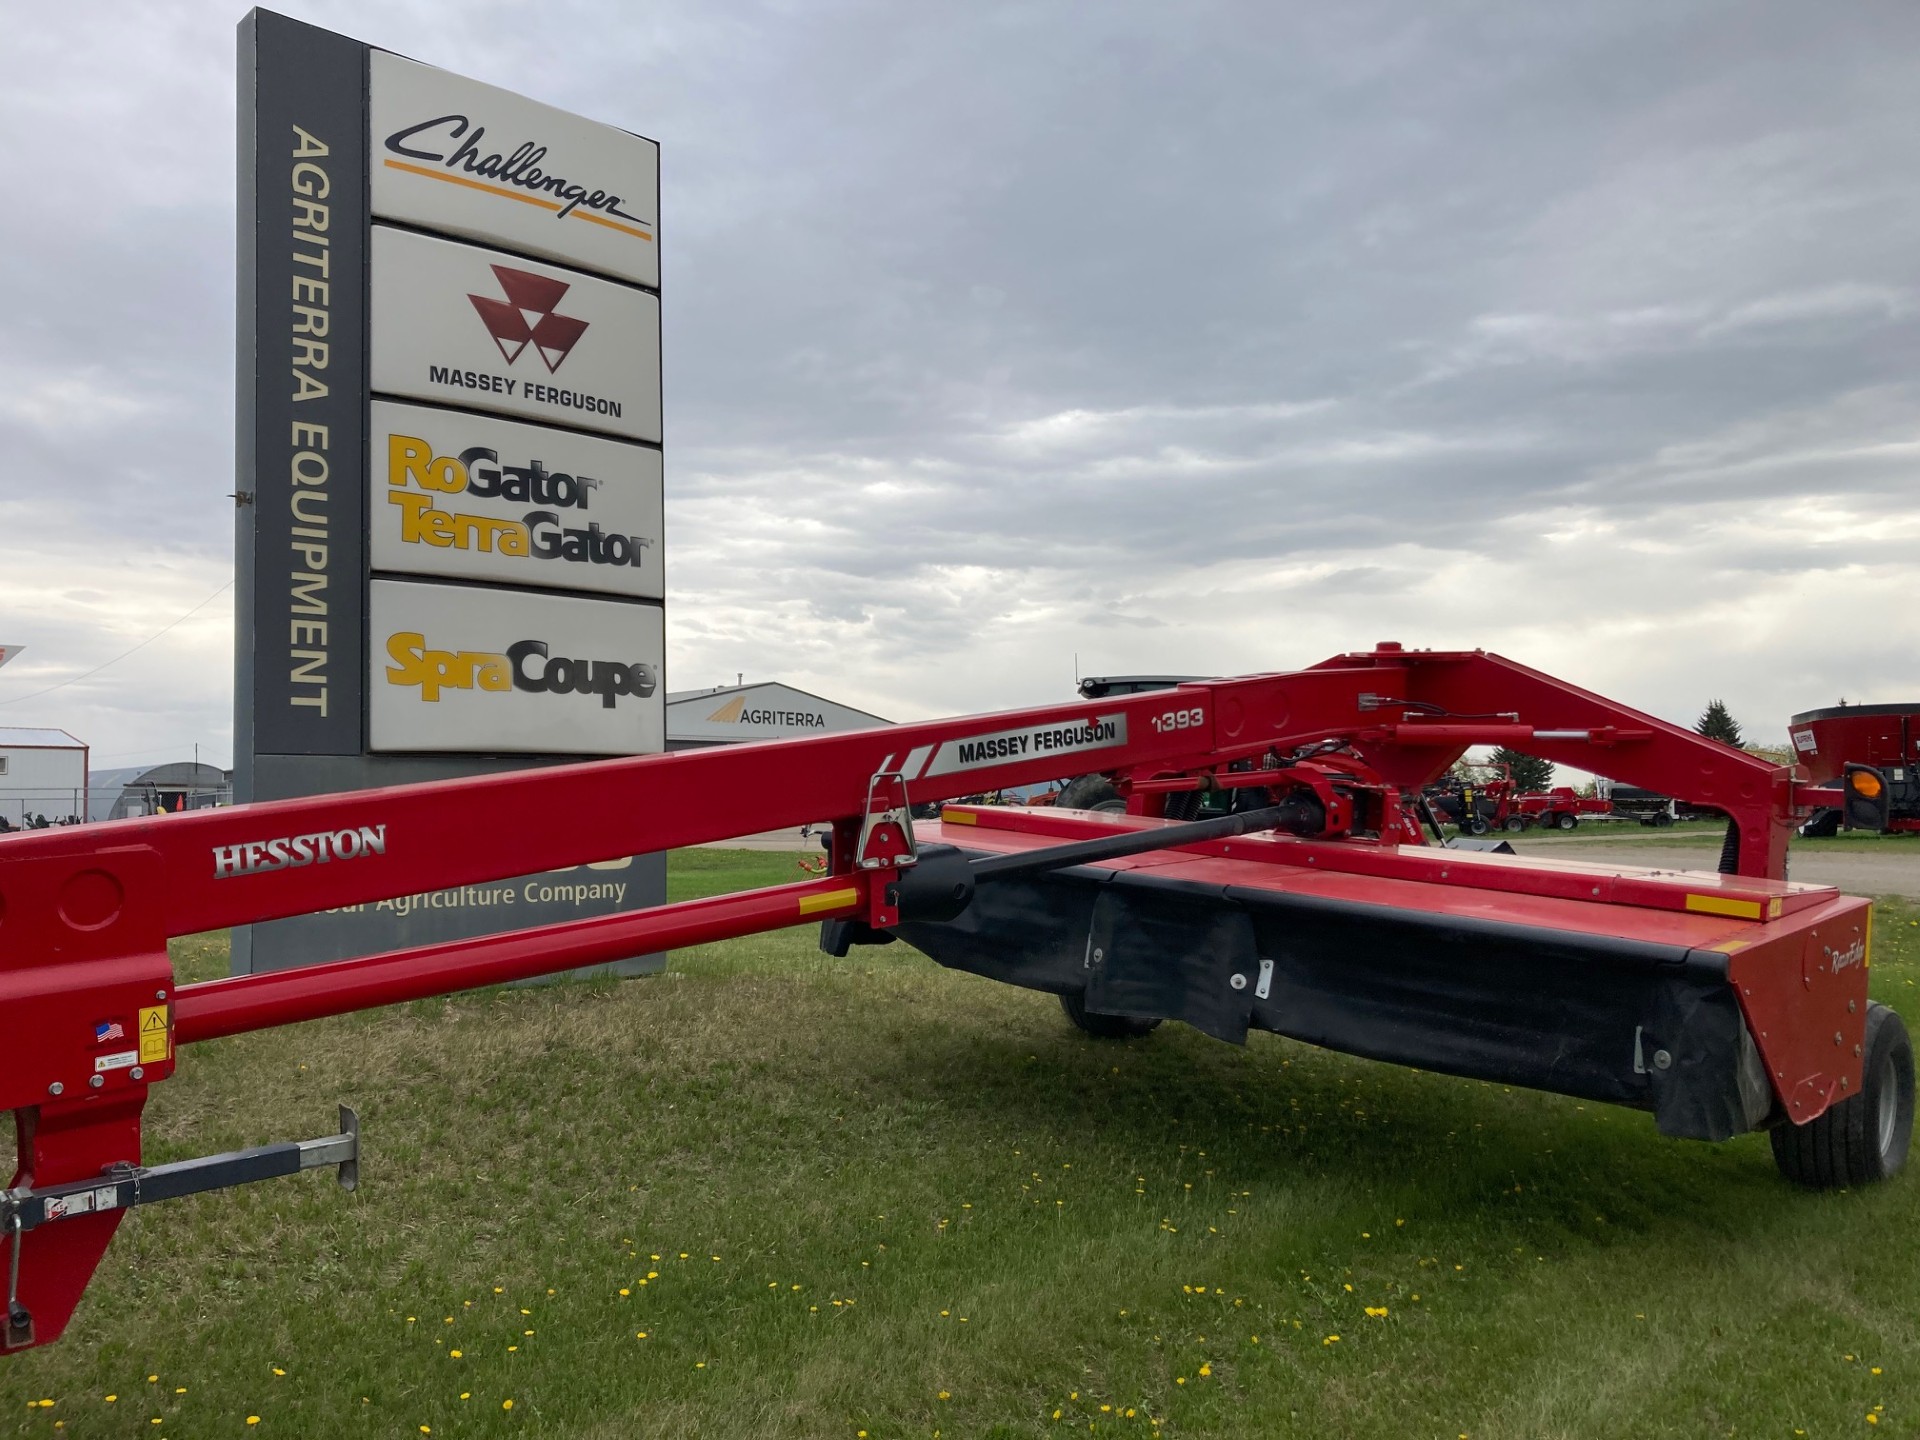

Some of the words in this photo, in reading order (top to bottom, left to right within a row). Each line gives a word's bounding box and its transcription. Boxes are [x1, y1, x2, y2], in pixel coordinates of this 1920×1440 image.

[384, 115, 652, 226] Challenger
[292, 124, 330, 402] AGRITERRA
[429, 366, 517, 395] MASSEY
[523, 382, 622, 418] FERGUSON
[388, 434, 597, 509] RoGator
[388, 490, 649, 567] TerraGator
[290, 421, 329, 718] EQUIPMENT
[385, 631, 656, 708] SpraCoupe
[740, 709, 825, 727] AGRITERRA
[959, 735, 1029, 763] MASSEY
[1033, 722, 1115, 751] FERGUSON
[1151, 707, 1204, 732] 1393
[212, 824, 387, 879] HESSTON
[524, 882, 627, 906] Company
